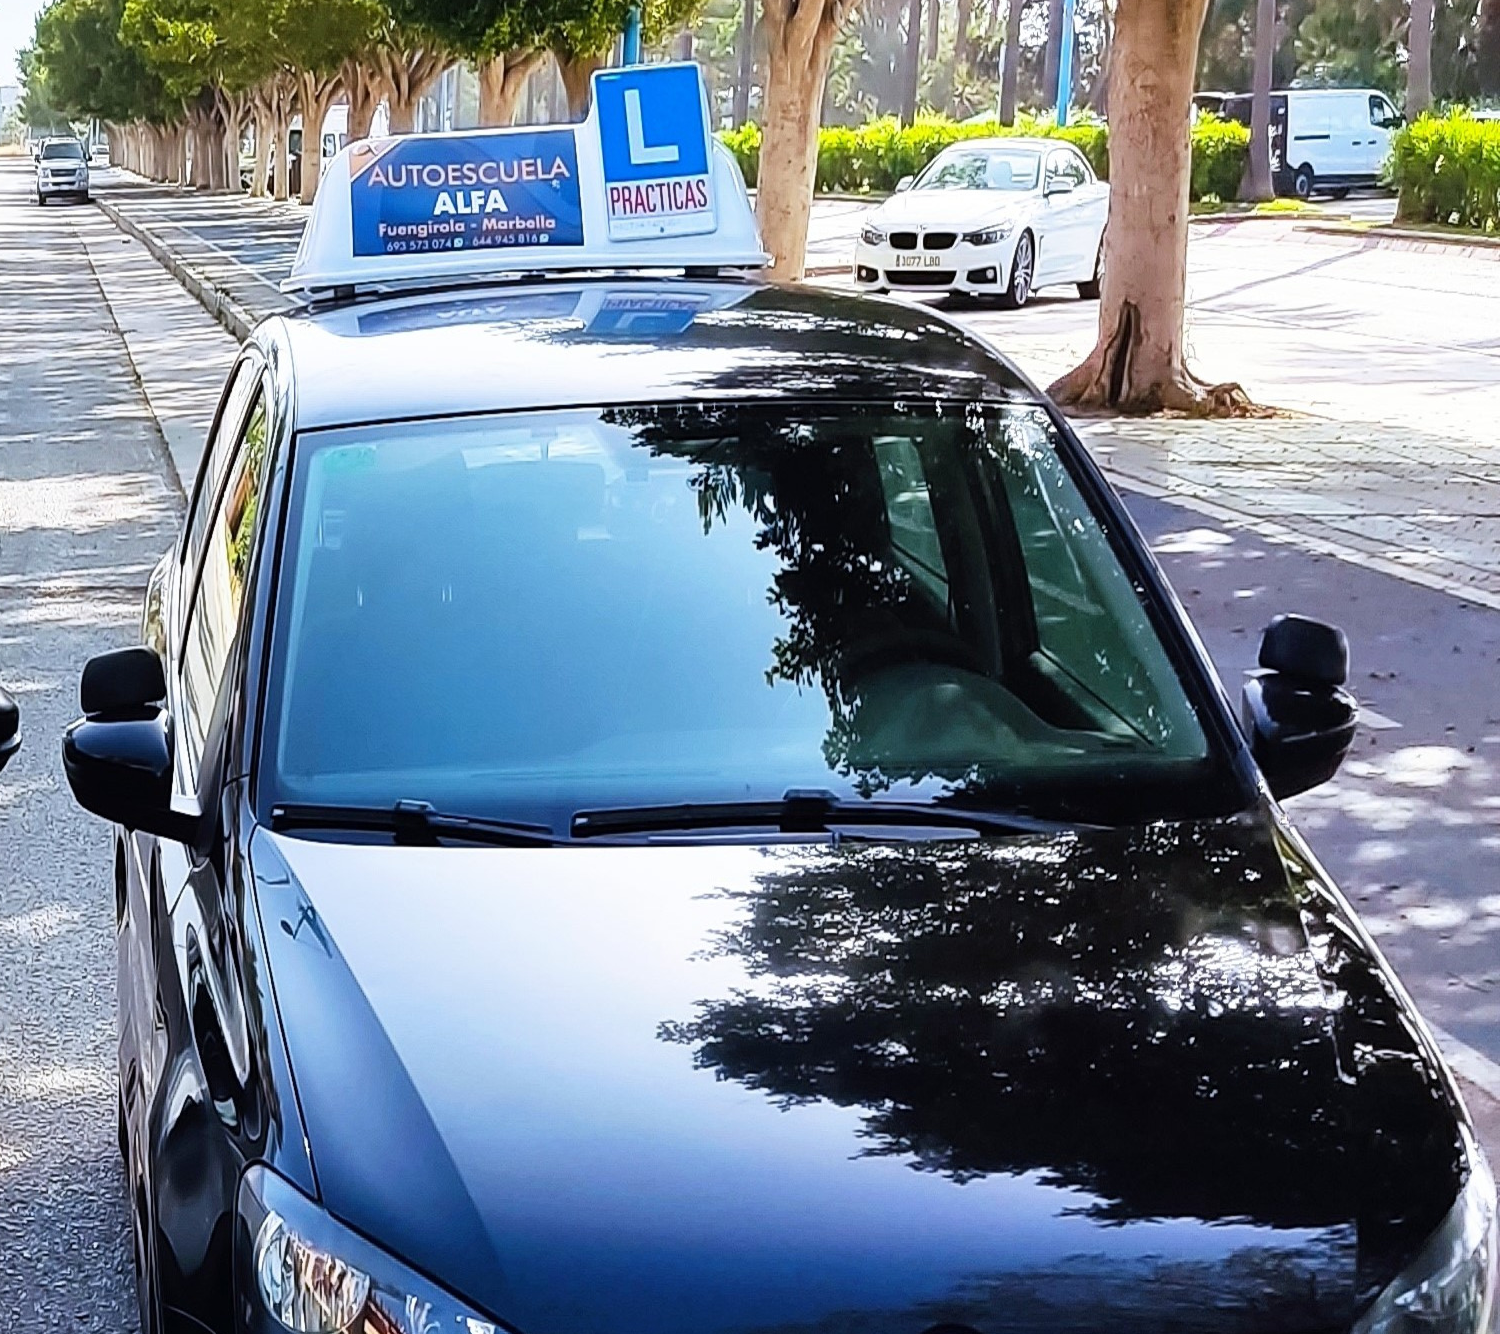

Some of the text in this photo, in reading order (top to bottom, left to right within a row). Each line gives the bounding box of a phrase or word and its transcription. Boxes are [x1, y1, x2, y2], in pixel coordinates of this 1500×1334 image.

[624, 88, 680, 165] L
[367, 155, 570, 188] AUTOESCUELA
[433, 189, 509, 216] ALFA
[609, 179, 708, 217] PRACTICAS
[378, 218, 466, 238] Fuengirola
[482, 214, 557, 231] Marbella
[386, 241, 407, 252] 693
[431, 237, 452, 250] 074
